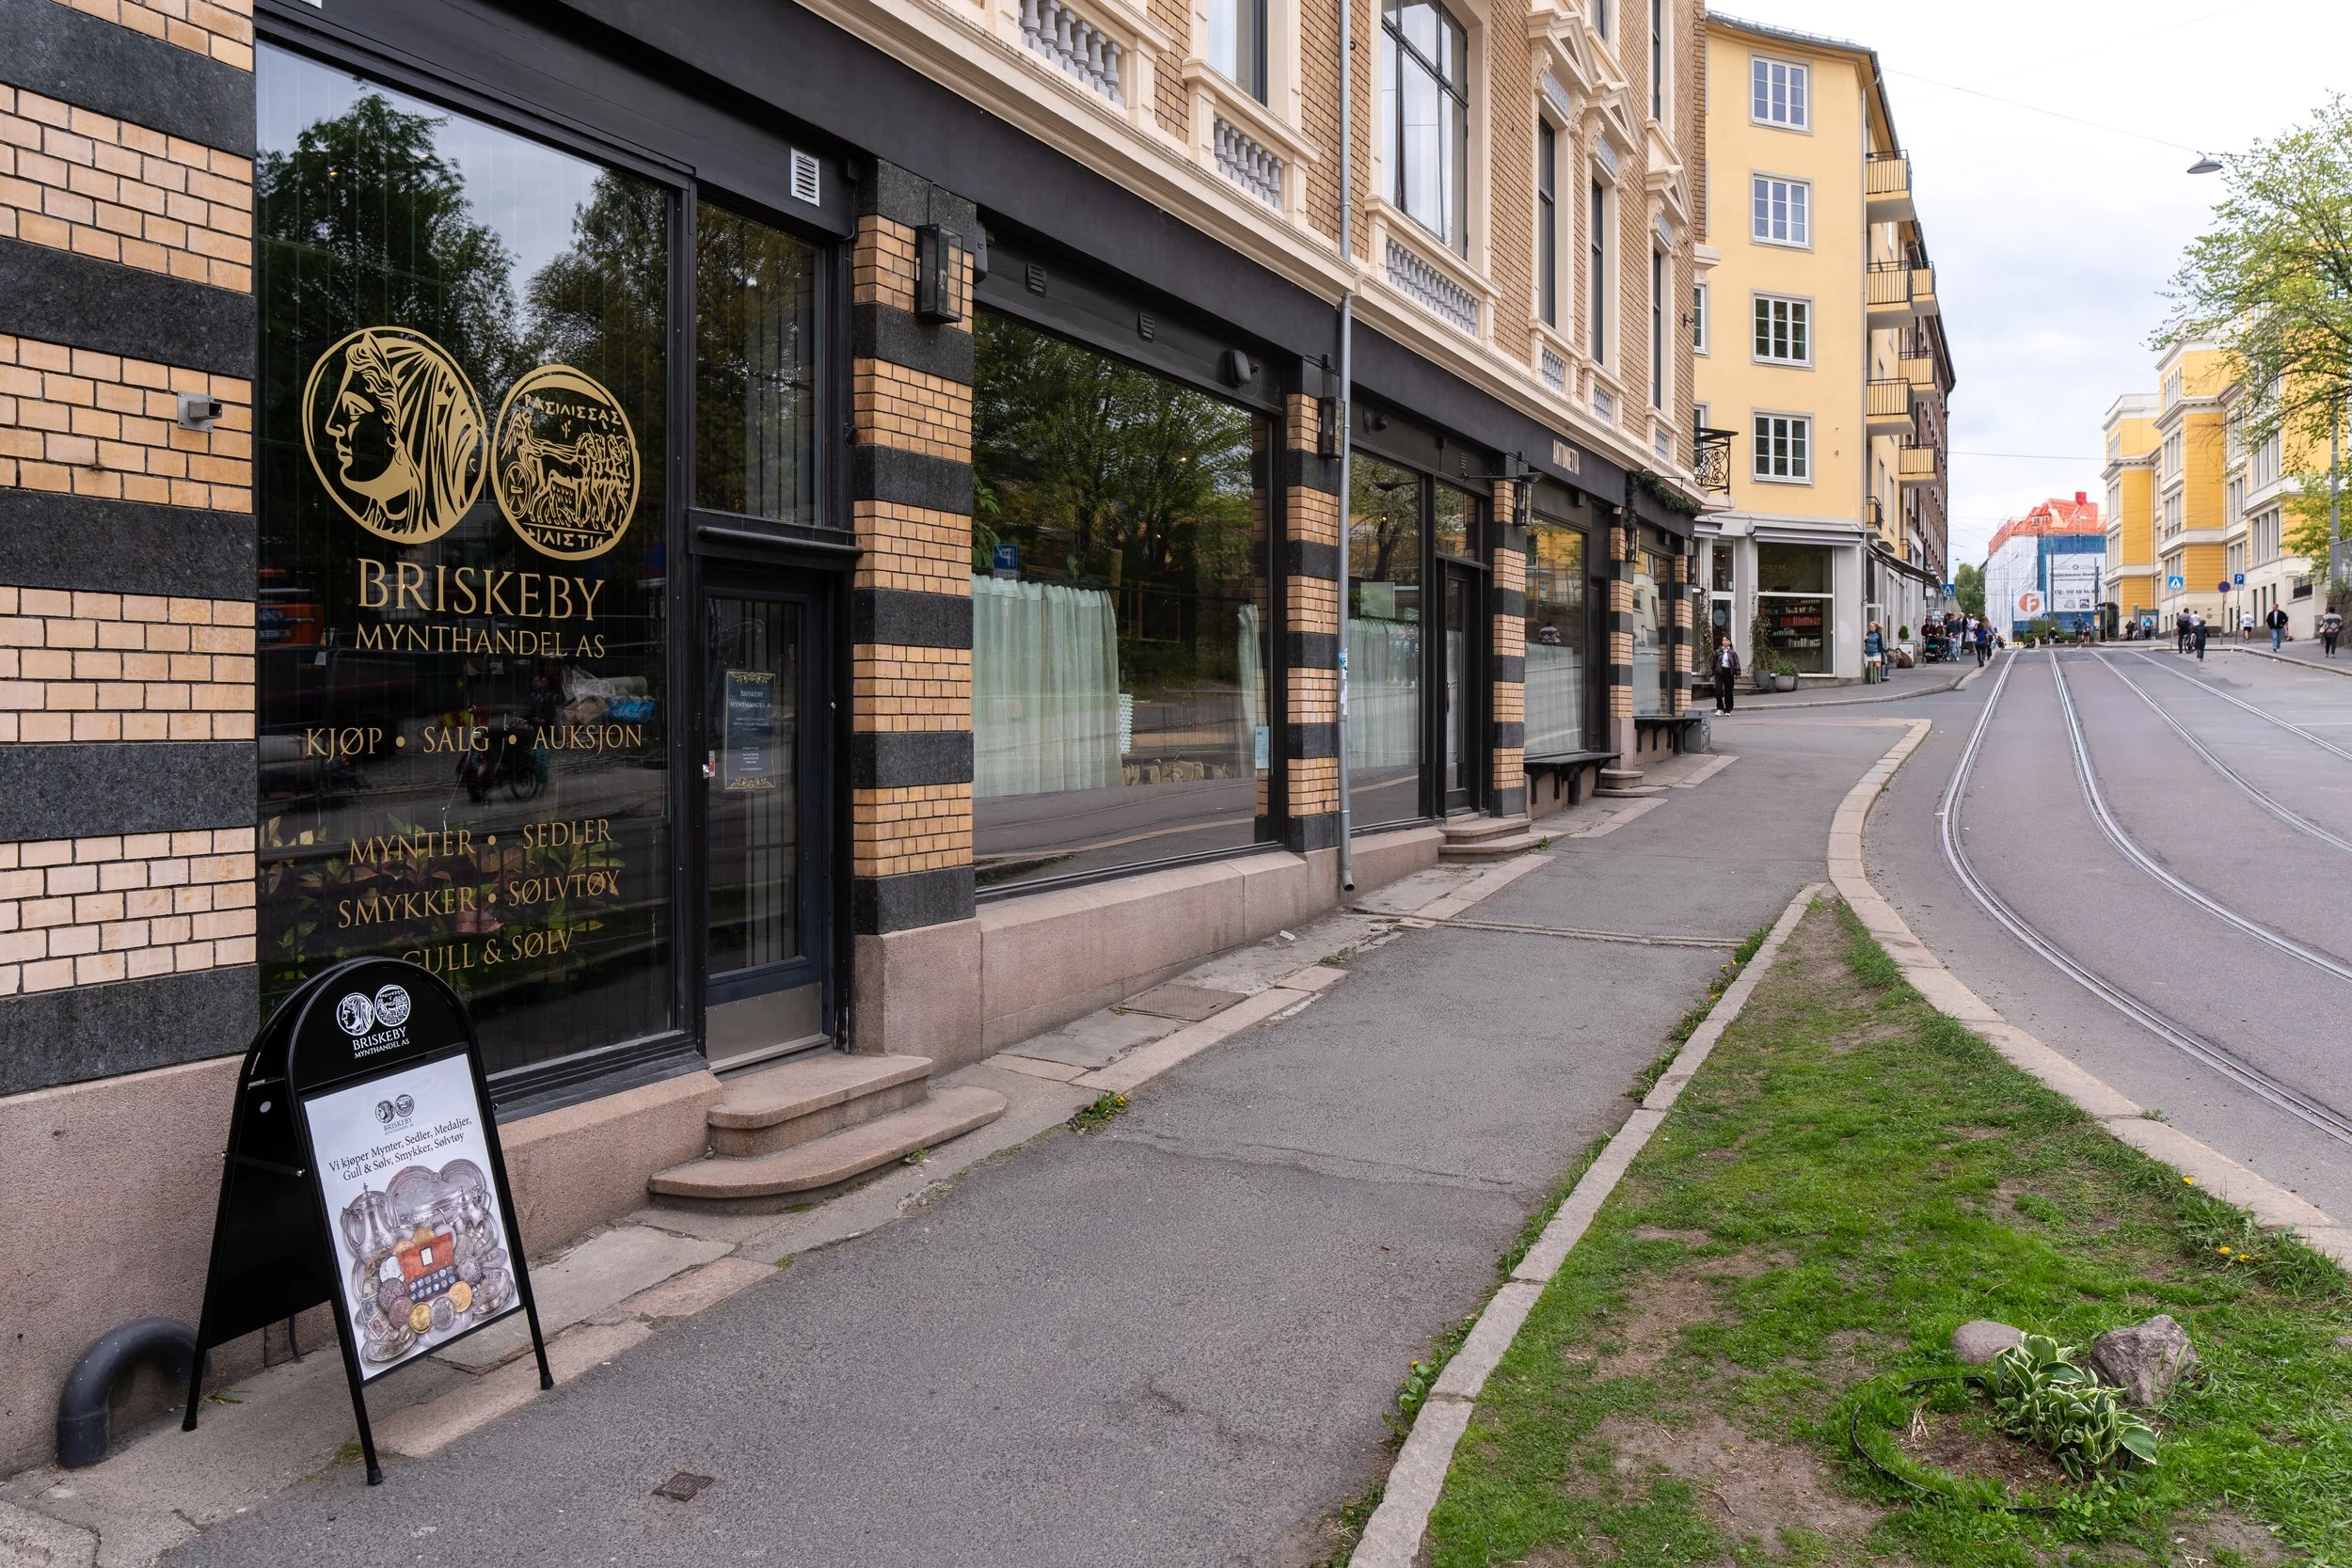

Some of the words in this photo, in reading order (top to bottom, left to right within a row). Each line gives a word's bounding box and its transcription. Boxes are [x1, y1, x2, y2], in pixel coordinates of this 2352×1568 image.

[357, 558, 605, 621] BRISKEBY
[356, 623, 568, 657] MYNTHANDEL
[576, 634, 605, 658] AS
[306, 726, 383, 764] KJØP
[423, 725, 490, 752] SALG
[532, 724, 644, 755] AUKSJON
[349, 830, 477, 865] MYNTER
[523, 818, 613, 849] SEDLER
[338, 887, 478, 929] SMYKKER
[509, 869, 620, 908] SØLVTØY
[484, 939, 504, 965] &
[512, 927, 574, 960] SØLV
[352, 1026, 406, 1051] BRISKEBY
[354, 1040, 401, 1059] MYNTHANDEL
[401, 1037, 410, 1046] AS
[328, 1160, 341, 1172] Vi
[341, 1151, 370, 1169] kjøper
[371, 1140, 405, 1158] Mynter,
[405, 1130, 434, 1146] Sedler,
[434, 1117, 472, 1136] Medaljer,
[383, 1117, 413, 1132] BRISKEBY
[342, 1166, 362, 1181] Gull
[364, 1163, 373, 1174] &
[373, 1157, 394, 1171] Sølv,
[394, 1144, 434, 1164] Smykker,
[434, 1132, 465, 1149] Sølvtøy
